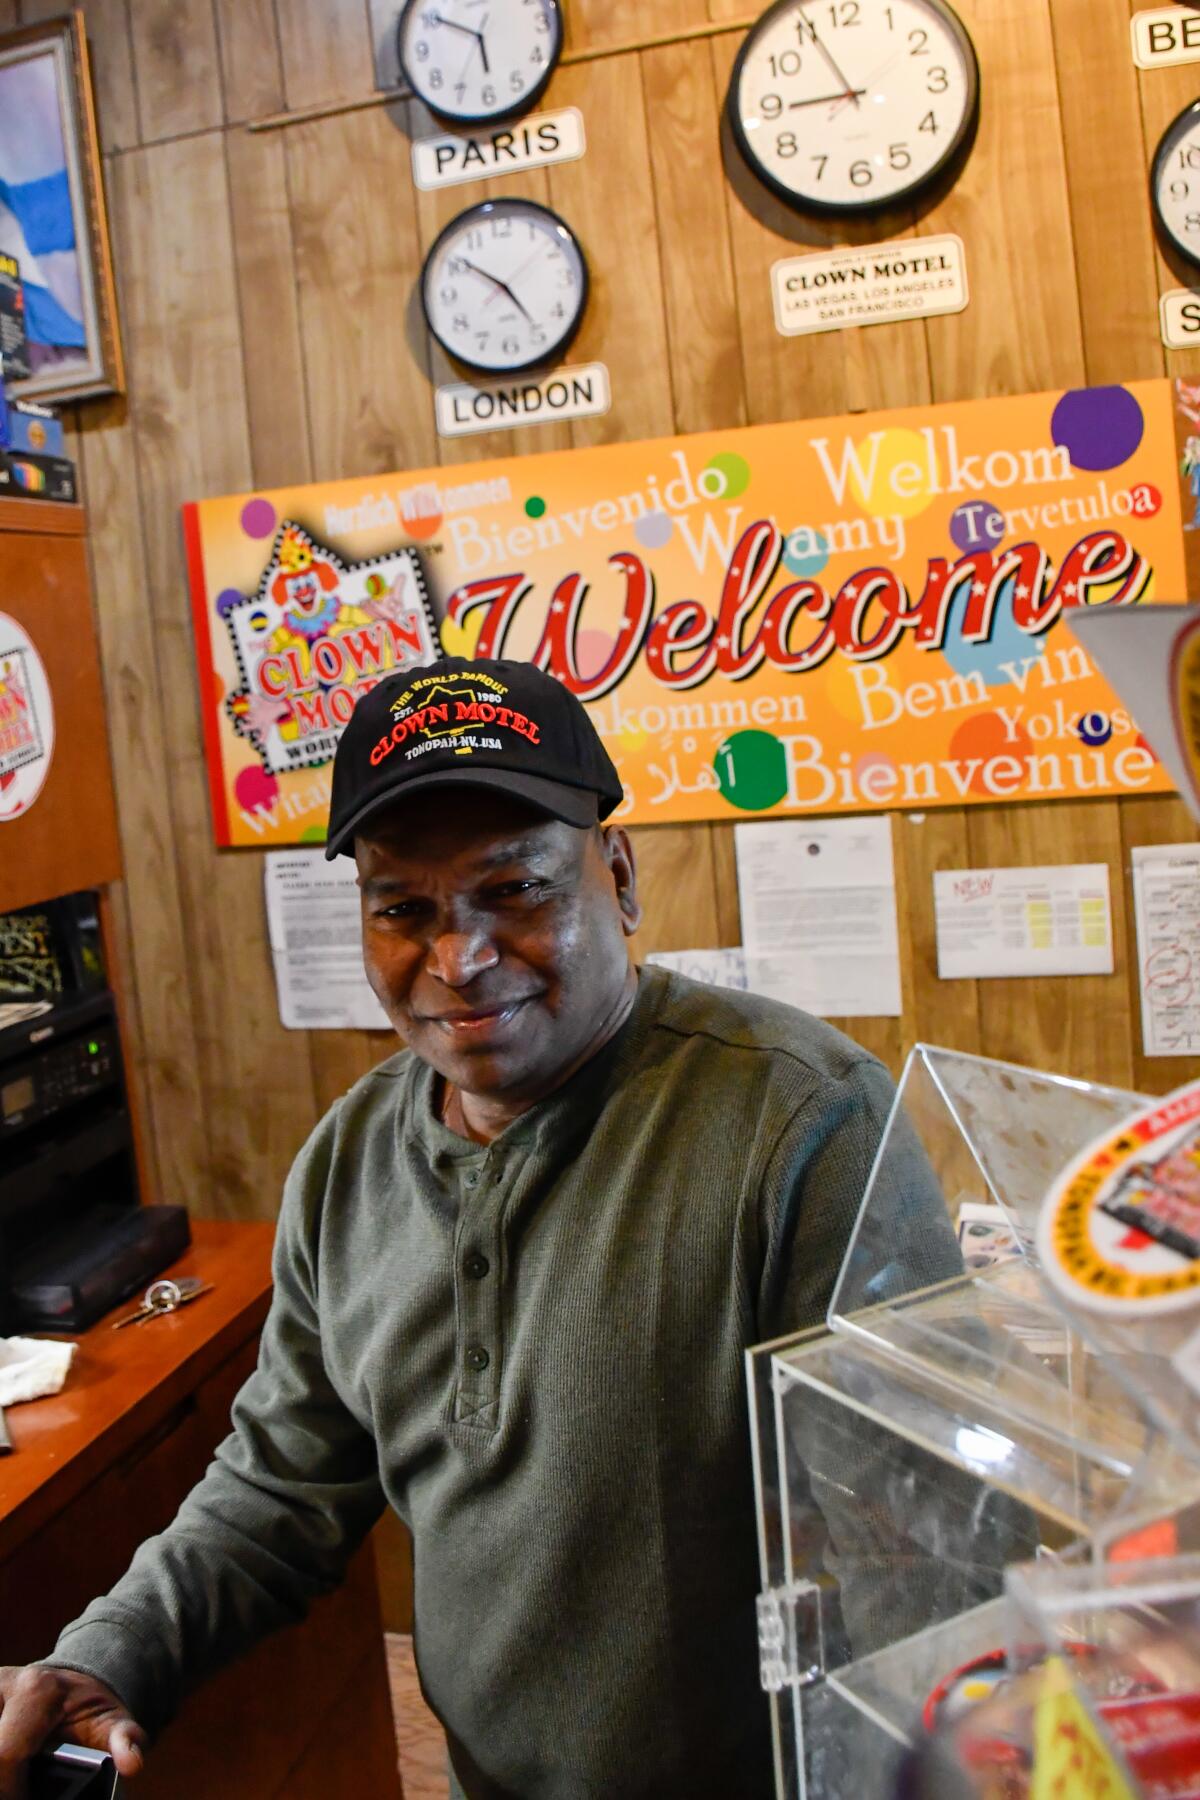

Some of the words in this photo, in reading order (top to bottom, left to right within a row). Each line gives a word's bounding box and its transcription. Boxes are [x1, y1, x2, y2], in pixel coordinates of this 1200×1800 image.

[828, 2, 861, 28] 12
[884, 8, 894, 31] 1
[415, 42, 429, 62] 9
[529, 46, 543, 64] 4
[907, 29, 930, 56] 2
[768, 50, 801, 78] 10
[429, 68, 443, 90] 8
[509, 70, 525, 93] 5
[926, 66, 949, 93] 3
[454, 82, 467, 105] 7
[481, 85, 496, 107] 6
[760, 94, 782, 120] 9
[917, 110, 939, 135] 4
[434, 124, 560, 174] PARIS
[776, 132, 798, 158] 8
[889, 142, 911, 170] 5
[811, 154, 829, 181] 7
[850, 161, 873, 187] 6
[1170, 180, 1189, 202] 9
[490, 217, 511, 238] 12
[786, 267, 866, 292] CLOWN
[874, 255, 952, 279] MOTEL
[441, 287, 457, 305] 9
[453, 314, 469, 332] 8
[475, 331, 489, 351] 7
[502, 335, 519, 355] 6
[453, 377, 593, 423] LONDON
[810, 425, 1075, 507] Welkom
[447, 450, 728, 573] Bienvenido
[953, 482, 1156, 543] Tervetuloa
[672, 505, 906, 577] Wamy
[447, 519, 1153, 702] Welcome
[258, 616, 423, 696] CLOWN
[390, 691, 414, 713] THE
[410, 673, 459, 692] WORLD
[461, 671, 509, 695] FAMOUS
[847, 661, 992, 730] Bem
[998, 639, 1100, 693] vin
[393, 706, 414, 722] EST.
[477, 692, 502, 704] 1980
[369, 703, 449, 767] CLOWN
[455, 701, 542, 745] MOTEL
[405, 736, 458, 760] TONOPAH
[481, 737, 503, 750] USA
[777, 733, 1155, 808] Bienvenue
